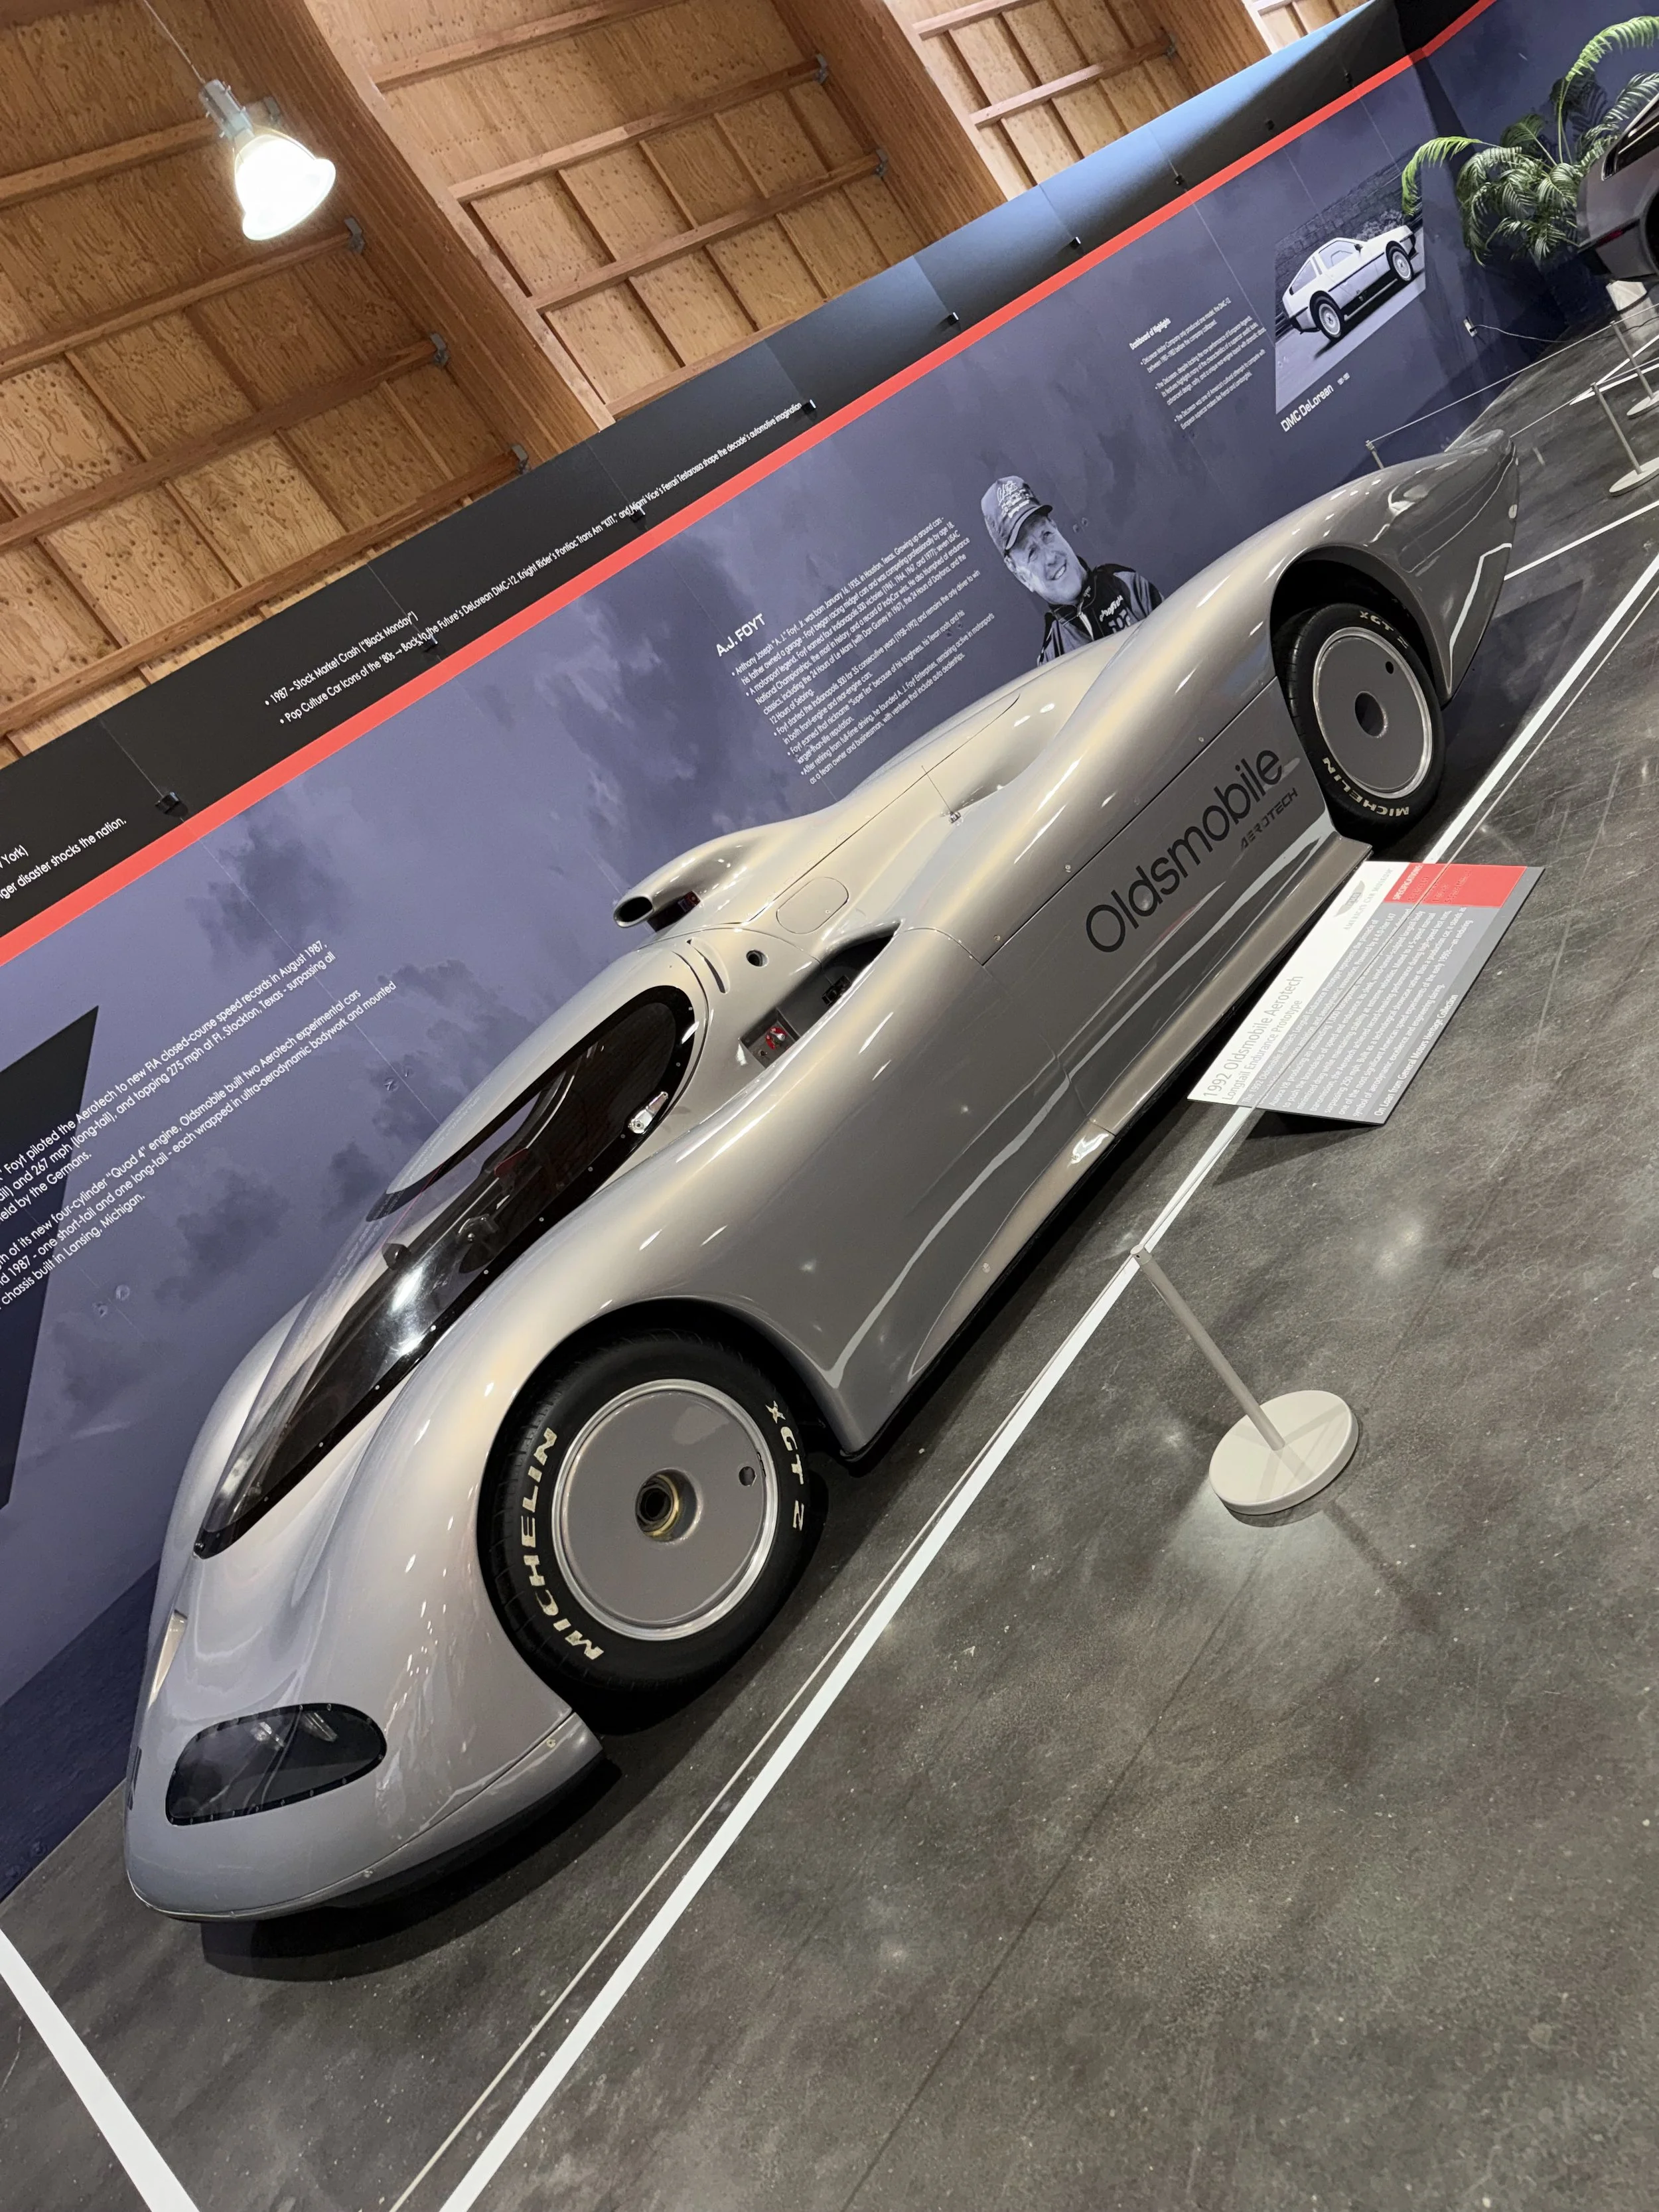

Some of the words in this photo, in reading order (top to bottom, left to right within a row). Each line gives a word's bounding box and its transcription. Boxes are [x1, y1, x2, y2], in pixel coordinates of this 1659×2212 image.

[1280, 409, 1302, 432] DMC
[1298, 384, 1334, 417] DeLorean
[284, 708, 302, 722] Pop
[300, 693, 328, 712] Culture
[326, 683, 342, 696] Car
[339, 672, 361, 688] Icons
[360, 665, 369, 677] of
[366, 660, 381, 672] the
[378, 652, 396, 663] '80s
[400, 636, 422, 652] Back
[425, 625, 439, 636] the
[437, 609, 464, 629] Future's
[461, 591, 494, 614] DeLorean
[490, 575, 520, 596] DMC-12,
[516, 562, 538, 580] Knight
[535, 552, 557, 569] Rider's
[554, 539, 579, 557] Pontiac
[575, 530, 593, 543] Trans
[591, 524, 603, 536] Am
[644, 487, 664, 500] Vice's
[660, 476, 680, 492] Ferrari
[676, 463, 704, 482] Testarossa
[702, 453, 719, 467] shape
[716, 448, 728, 457] the
[726, 433, 751, 452] decade's
[749, 418, 776, 438] automotive
[773, 402, 802, 422] imagination
[735, 656, 757, 675] Anthony
[755, 643, 774, 660] Joseph
[804, 612, 815, 623] was
[812, 605, 826, 617] born
[824, 591, 843, 609] January
[893, 539, 914, 555] Growing
[917, 522, 934, 538] around
[932, 517, 942, 528] cars
[269, 686, 288, 703] 1987
[293, 672, 316, 690] Stock
[313, 656, 340, 678] Market
[338, 646, 361, 662] Crash
[358, 631, 385, 652] ("Black
[382, 611, 418, 636] Monday")
[716, 636, 738, 656] A.J.
[734, 613, 765, 641] FOYT
[1240, 787, 1298, 851] AEROTECH
[1322, 757, 1409, 817] MICHELIN
[1, 845, 29, 864] York)
[17, 861, 51, 887] disaster
[50, 844, 81, 866] shocks
[78, 835, 96, 848] the
[95, 818, 127, 839] nation.
[1086, 750, 1282, 952] Oldsmobile
[1202, 1072, 1232, 1096] 1992
[1223, 1017, 1273, 1070] Oldsmobile
[1263, 976, 1303, 1016] Aerotech
[1422, 1018, 1443, 1040] Heritage
[1436, 994, 1459, 1018] Collection
[3, 1153, 27, 1174] Foyt
[25, 1130, 60, 1161] piloted
[56, 1120, 76, 1135] the
[75, 1090, 117, 1124] Aerotech
[114, 1082, 127, 1093] to
[126, 1068, 147, 1086] new
[144, 1058, 162, 1072] FIA
[161, 1019, 217, 1061] closed-course
[216, 998, 243, 1021] speed
[241, 979, 272, 1003] records
[268, 974, 281, 983] in
[279, 953, 307, 977] August
[304, 940, 327, 957] 1987,
[12, 1169, 34, 1189] and
[31, 1157, 48, 1175] 267
[48, 1143, 72, 1163] mph
[70, 1111, 117, 1147] (long-tail),
[116, 1095, 135, 1114] and
[133, 1072, 169, 1100] topping
[166, 1059, 184, 1076] 275
[182, 1047, 204, 1065] mph
[203, 1038, 214, 1050] at
[211, 1032, 226, 1043] Ft.
[222, 1007, 262, 1035] Stockton,
[258, 990, 283, 1009] Texas
[287, 960, 326, 990] surpassing
[325, 951, 336, 963] all
[1221, 1070, 1251, 1100] Longtail
[1244, 1033, 1279, 1070] Endurance
[1270, 999, 1303, 1032] Prototype
[1397, 1058, 1417, 1079] General
[1409, 1040, 1429, 1059] Motors
[1374, 1107, 1386, 1116] On
[1379, 1093, 1396, 1107] Loan
[1387, 1080, 1404, 1092] from
[7, 1254, 31, 1276] 1987
[37, 1238, 58, 1255] one
[56, 1207, 96, 1241] short-tail
[95, 1191, 115, 1211] and
[114, 1181, 133, 1197] one
[130, 1151, 169, 1183] long-tail
[173, 1132, 196, 1152] each
[194, 1102, 234, 1134] wrapped
[230, 1098, 243, 1107] in
[240, 1045, 311, 1100] ultra-aerodynamic
[308, 1017, 348, 1049] bodywork
[346, 1004, 364, 1021] and
[362, 980, 396, 1009] mounted
[8, 1242, 21, 1256] of
[17, 1236, 33, 1248] its
[30, 1219, 52, 1239] new
[50, 1178, 108, 1223] four-cylinder
[106, 1153, 139, 1177] "Quad
[149, 1126, 182, 1150] engine,
[179, 1090, 226, 1126] Oldsmobile
[223, 1074, 245, 1092] built
[242, 1065, 260, 1079] two
[259, 1037, 297, 1068] Aerotech
[296, 1000, 344, 1040] experimental
[343, 990, 361, 1005] cars
[14, 1193, 31, 1207] by
[29, 1183, 48, 1197] the
[46, 1151, 92, 1184] Germans.
[1, 1276, 35, 1304] chassis
[31, 1258, 55, 1280] built
[52, 1253, 66, 1264] in
[62, 1226, 102, 1256] Lansing,
[100, 1194, 145, 1228] Michigan.
[765, 1400, 804, 1484] XGT
[521, 1428, 603, 1660] MICHELIN
